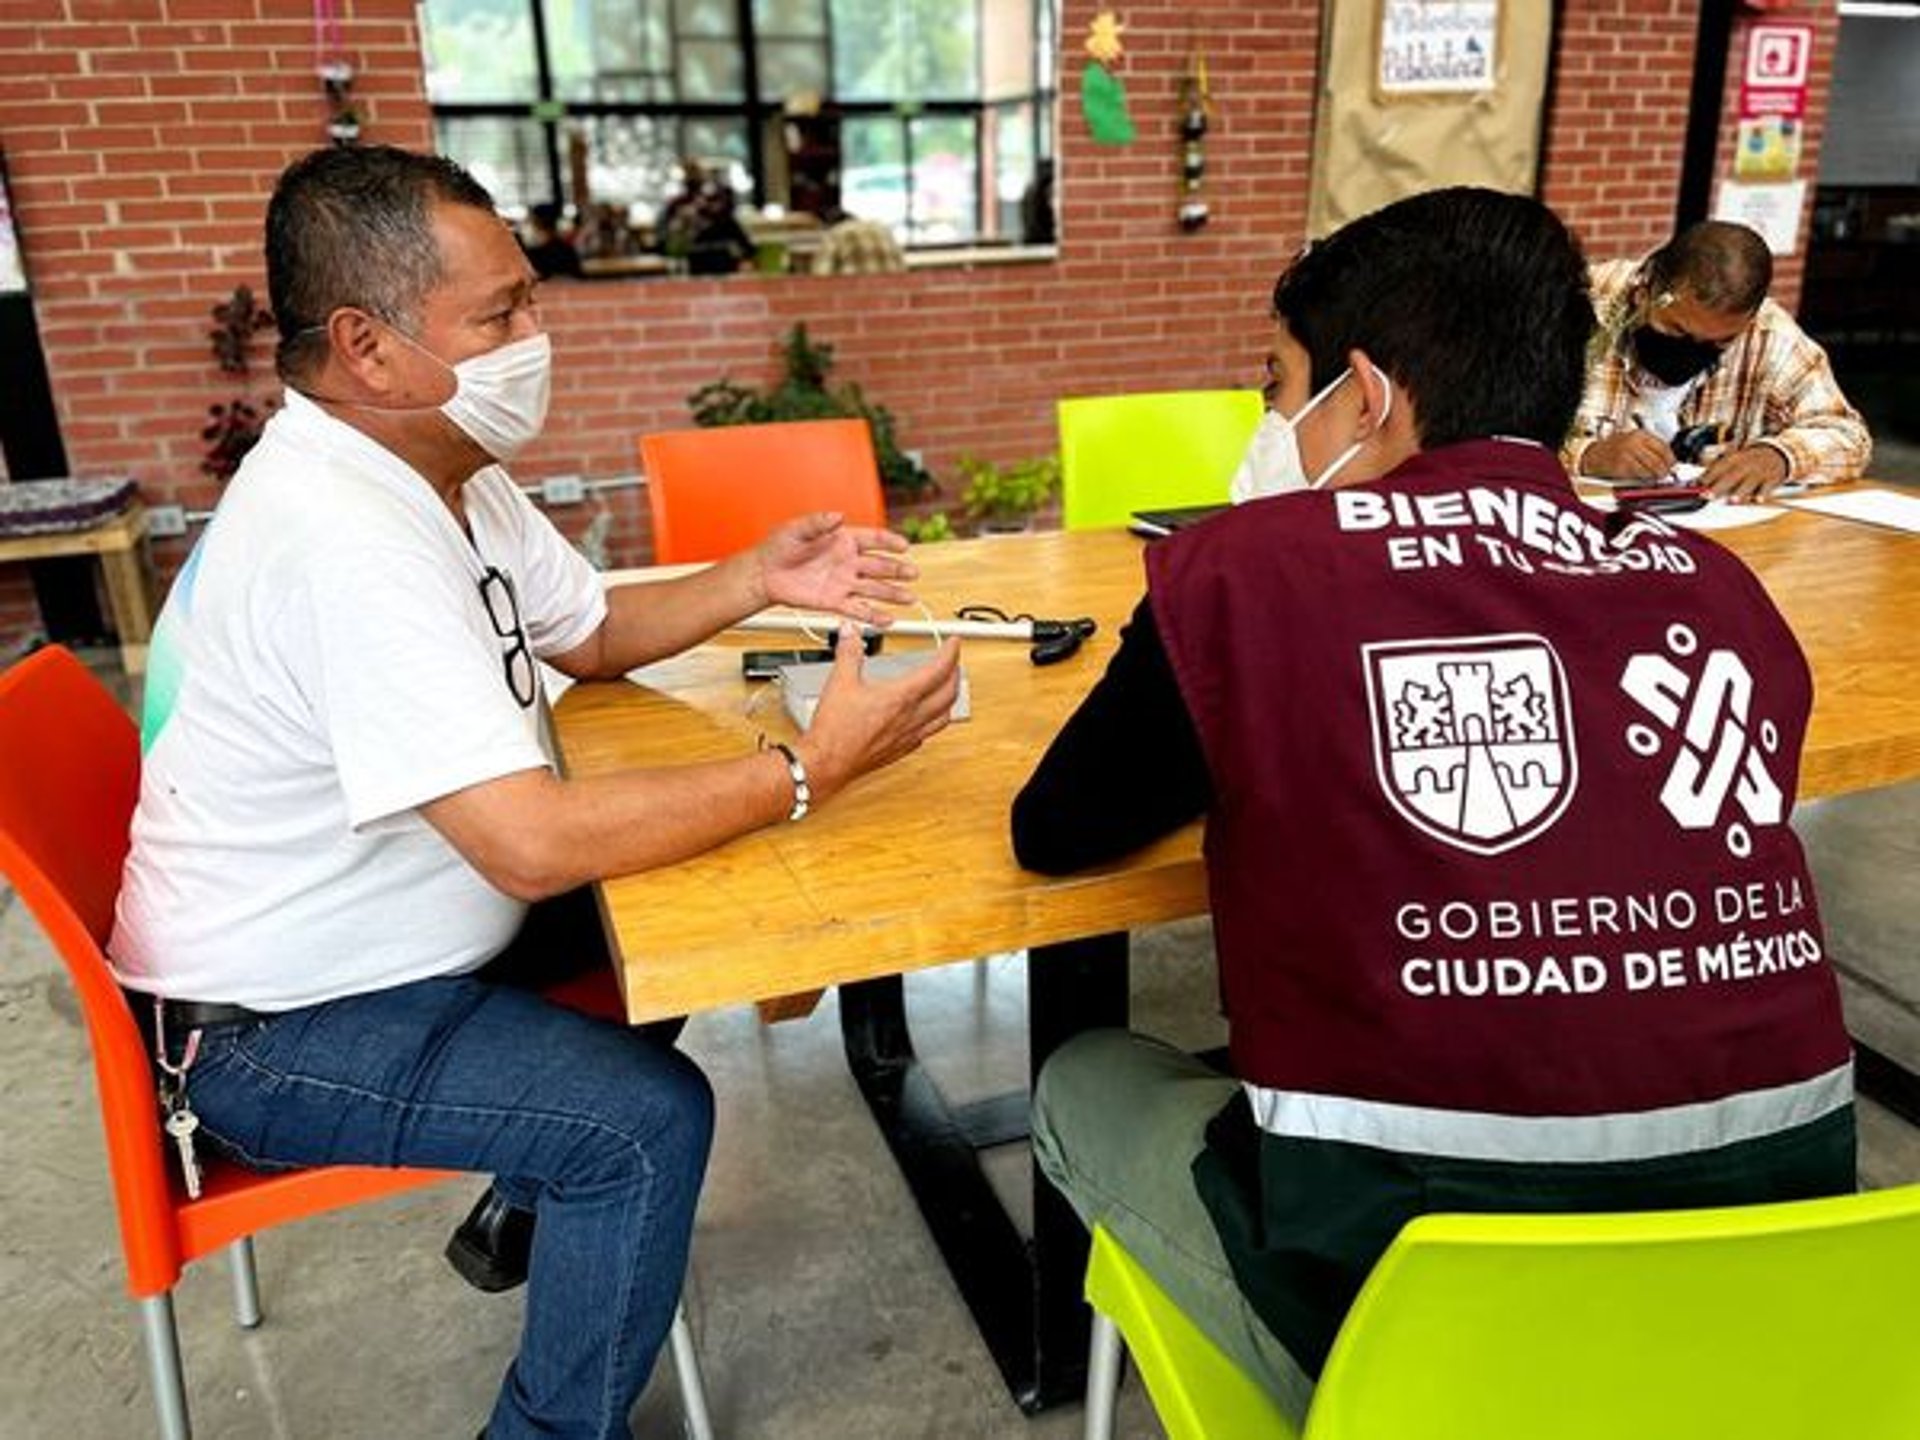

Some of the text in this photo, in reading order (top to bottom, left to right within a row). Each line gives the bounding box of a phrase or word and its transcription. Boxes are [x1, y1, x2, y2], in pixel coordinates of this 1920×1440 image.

[1387, 533, 1463, 570] EN
[1475, 533, 1534, 574] TU
[1396, 877, 1805, 940] GOBIERNO DE LA
[1400, 930, 1823, 997] CIUDAD DE MÉXICO
